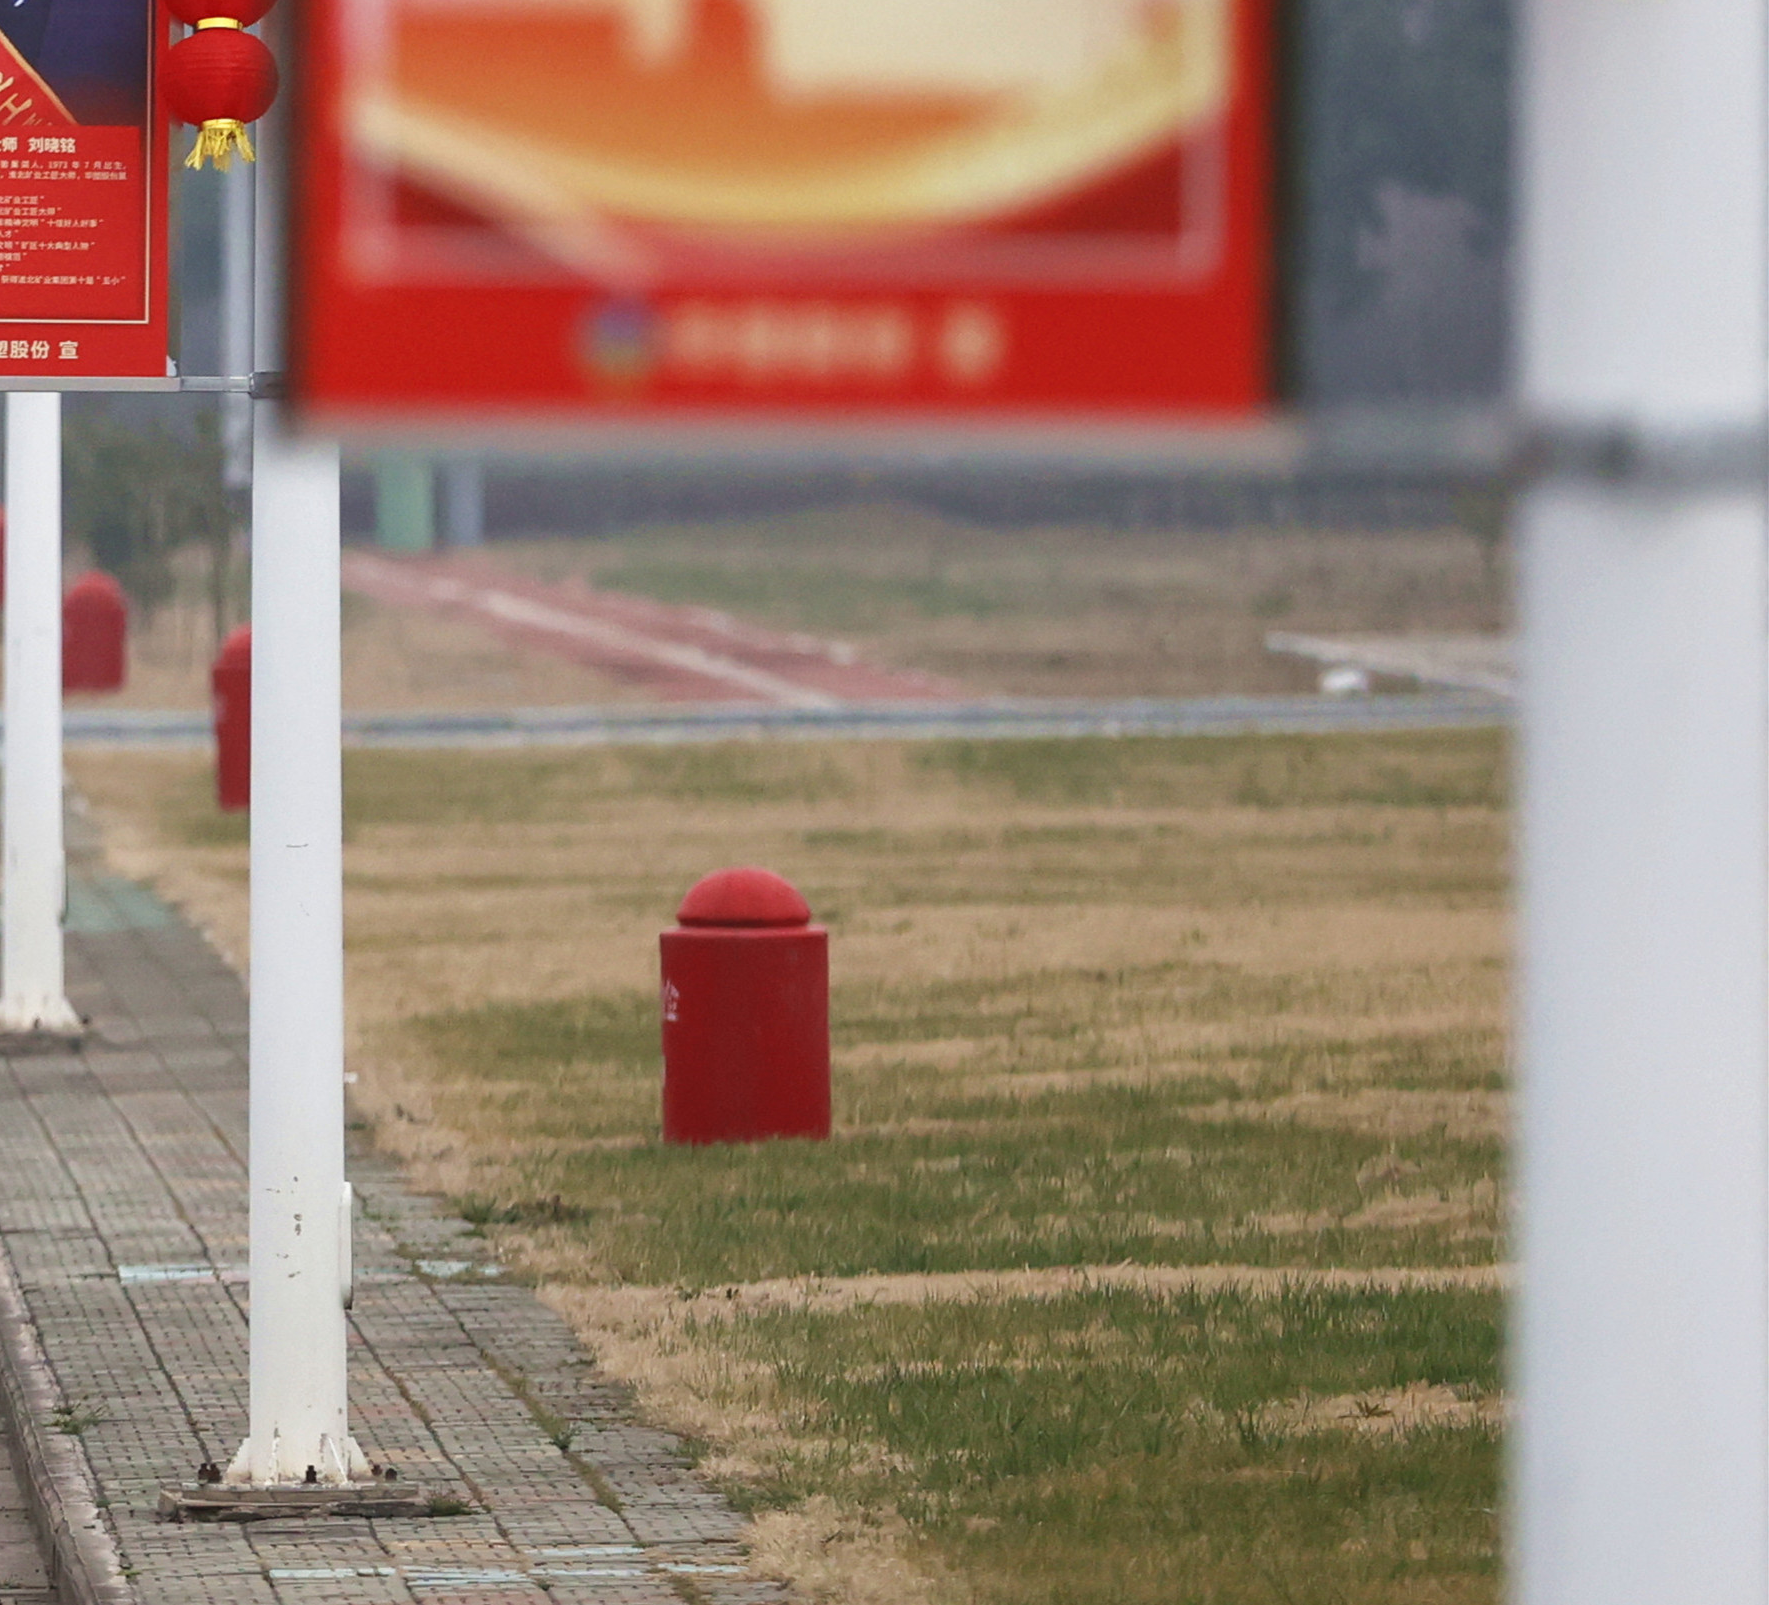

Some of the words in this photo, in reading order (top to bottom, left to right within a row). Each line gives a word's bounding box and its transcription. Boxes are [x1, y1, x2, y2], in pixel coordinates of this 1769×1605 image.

[28, 136, 76, 154] 刘晓铭
[59, 340, 79, 359] 宣
